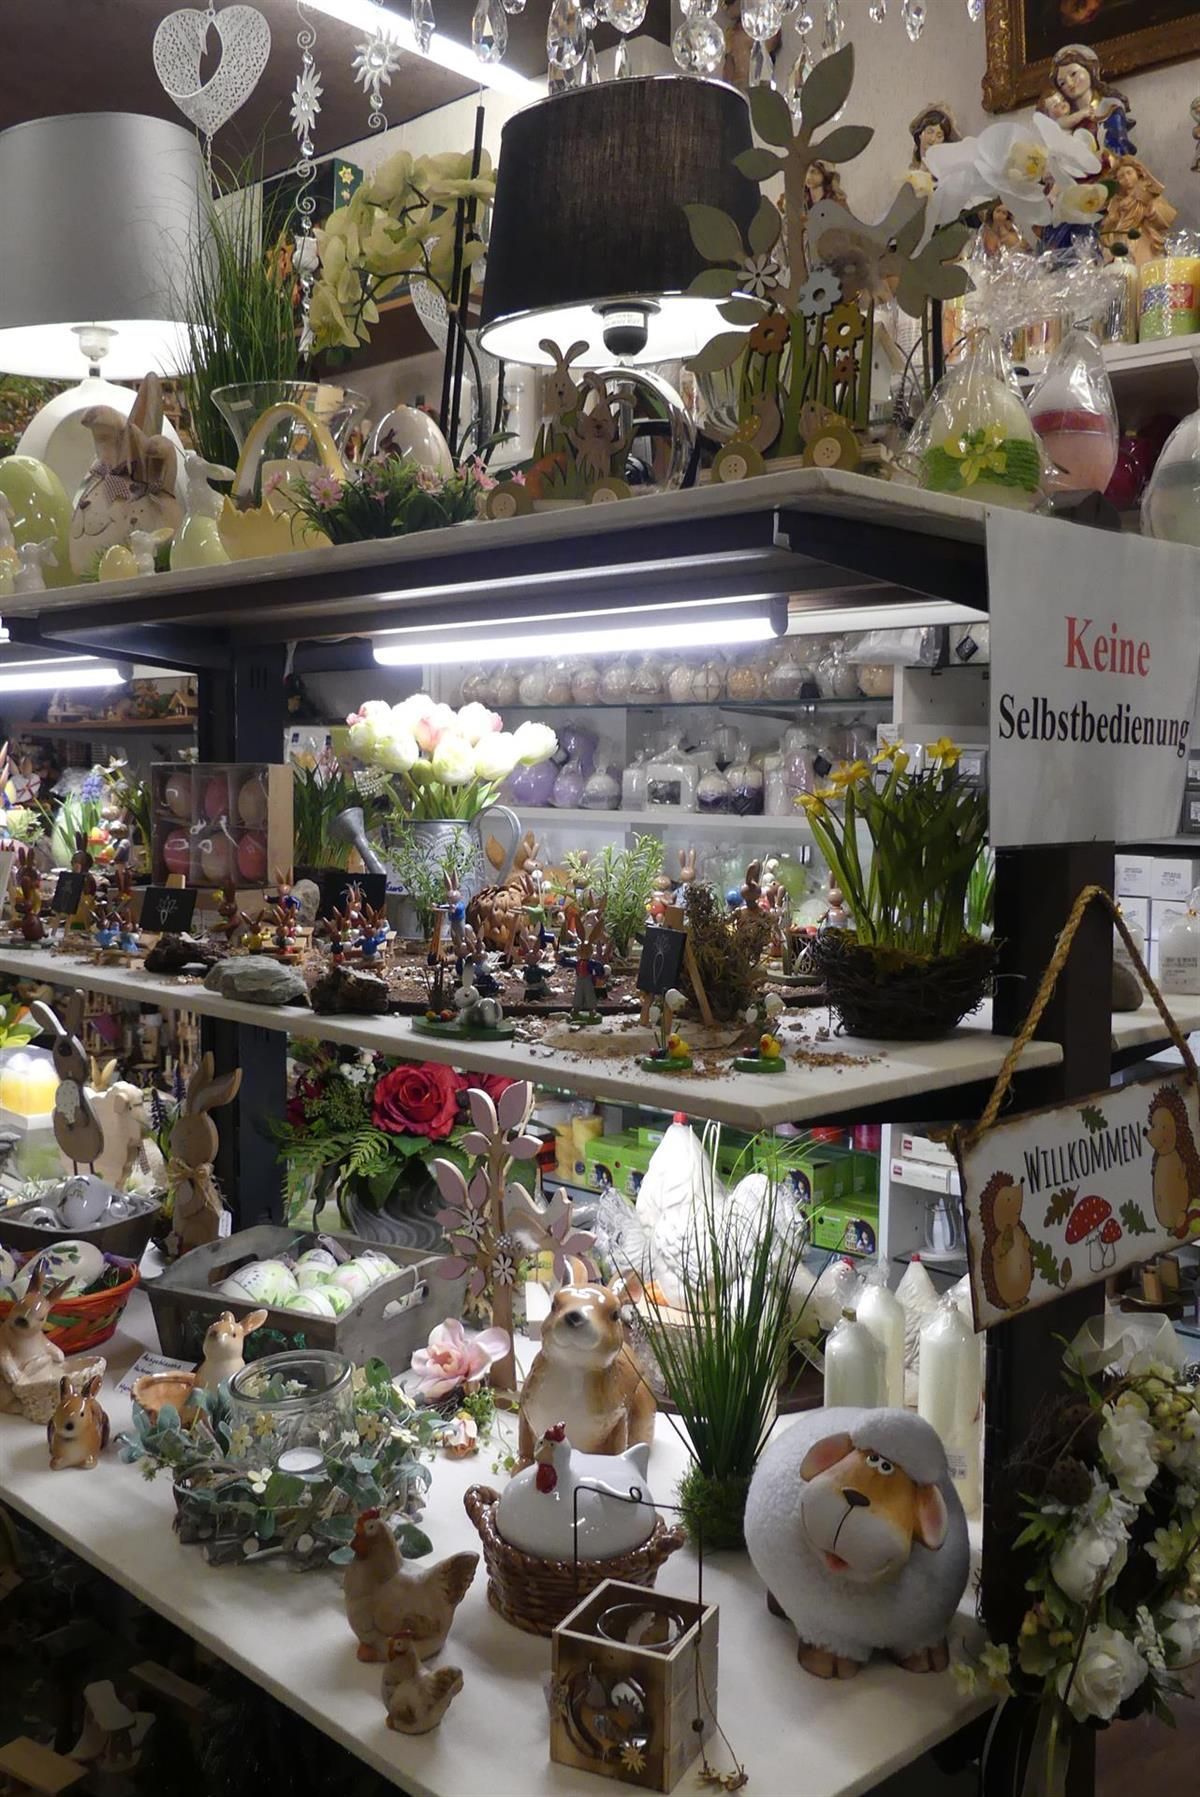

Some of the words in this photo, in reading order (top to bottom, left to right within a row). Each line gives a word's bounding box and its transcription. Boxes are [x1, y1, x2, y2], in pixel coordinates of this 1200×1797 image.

[1064, 616, 1151, 677] Keine
[999, 693, 1190, 758] Selbstbedienung
[1023, 1121, 1142, 1194] WILLKOMMEN
